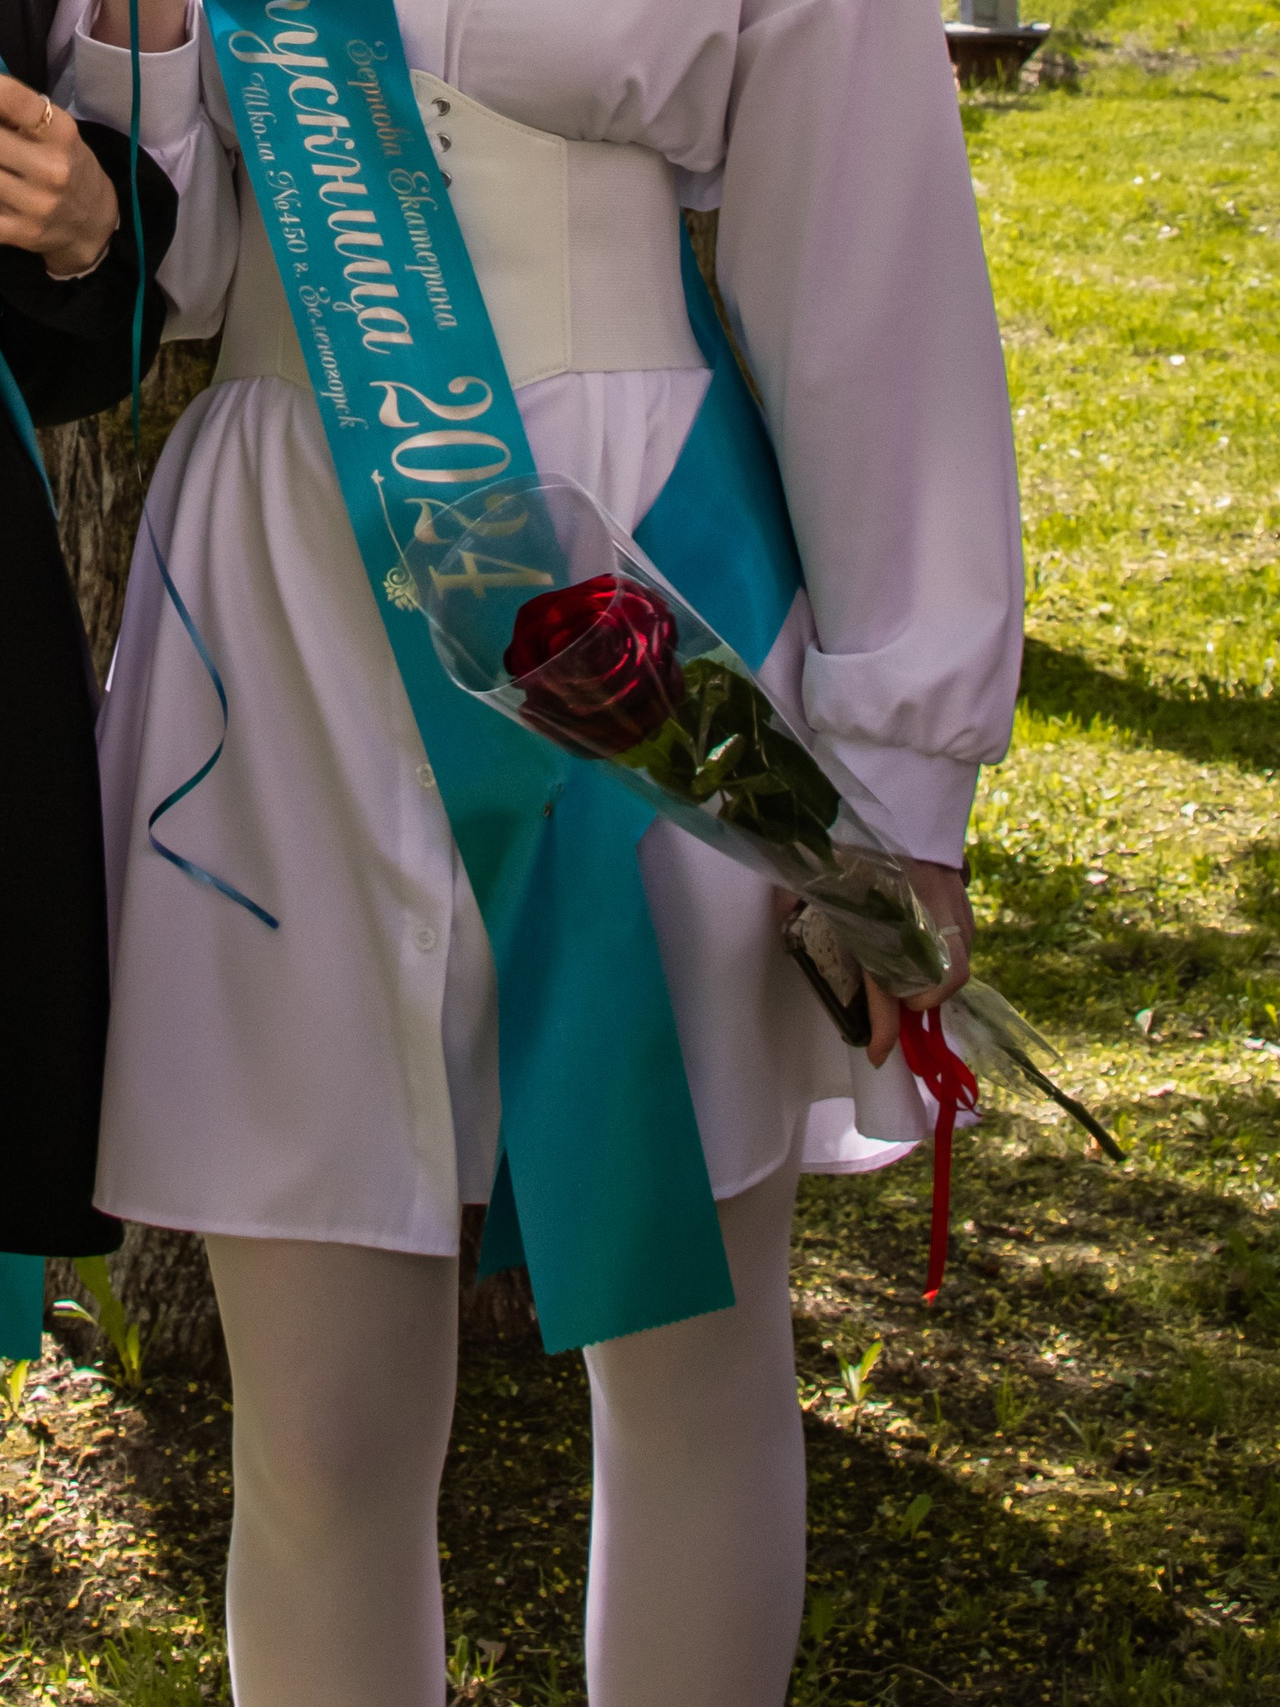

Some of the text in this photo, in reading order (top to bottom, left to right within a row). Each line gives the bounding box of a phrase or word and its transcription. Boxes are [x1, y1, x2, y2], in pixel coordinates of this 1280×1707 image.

[241, 71, 369, 430] Школа №450 г. Зеленогорск
[346, 38, 459, 331] Зернова Екатерина
[369, 375, 555, 600] 2024
